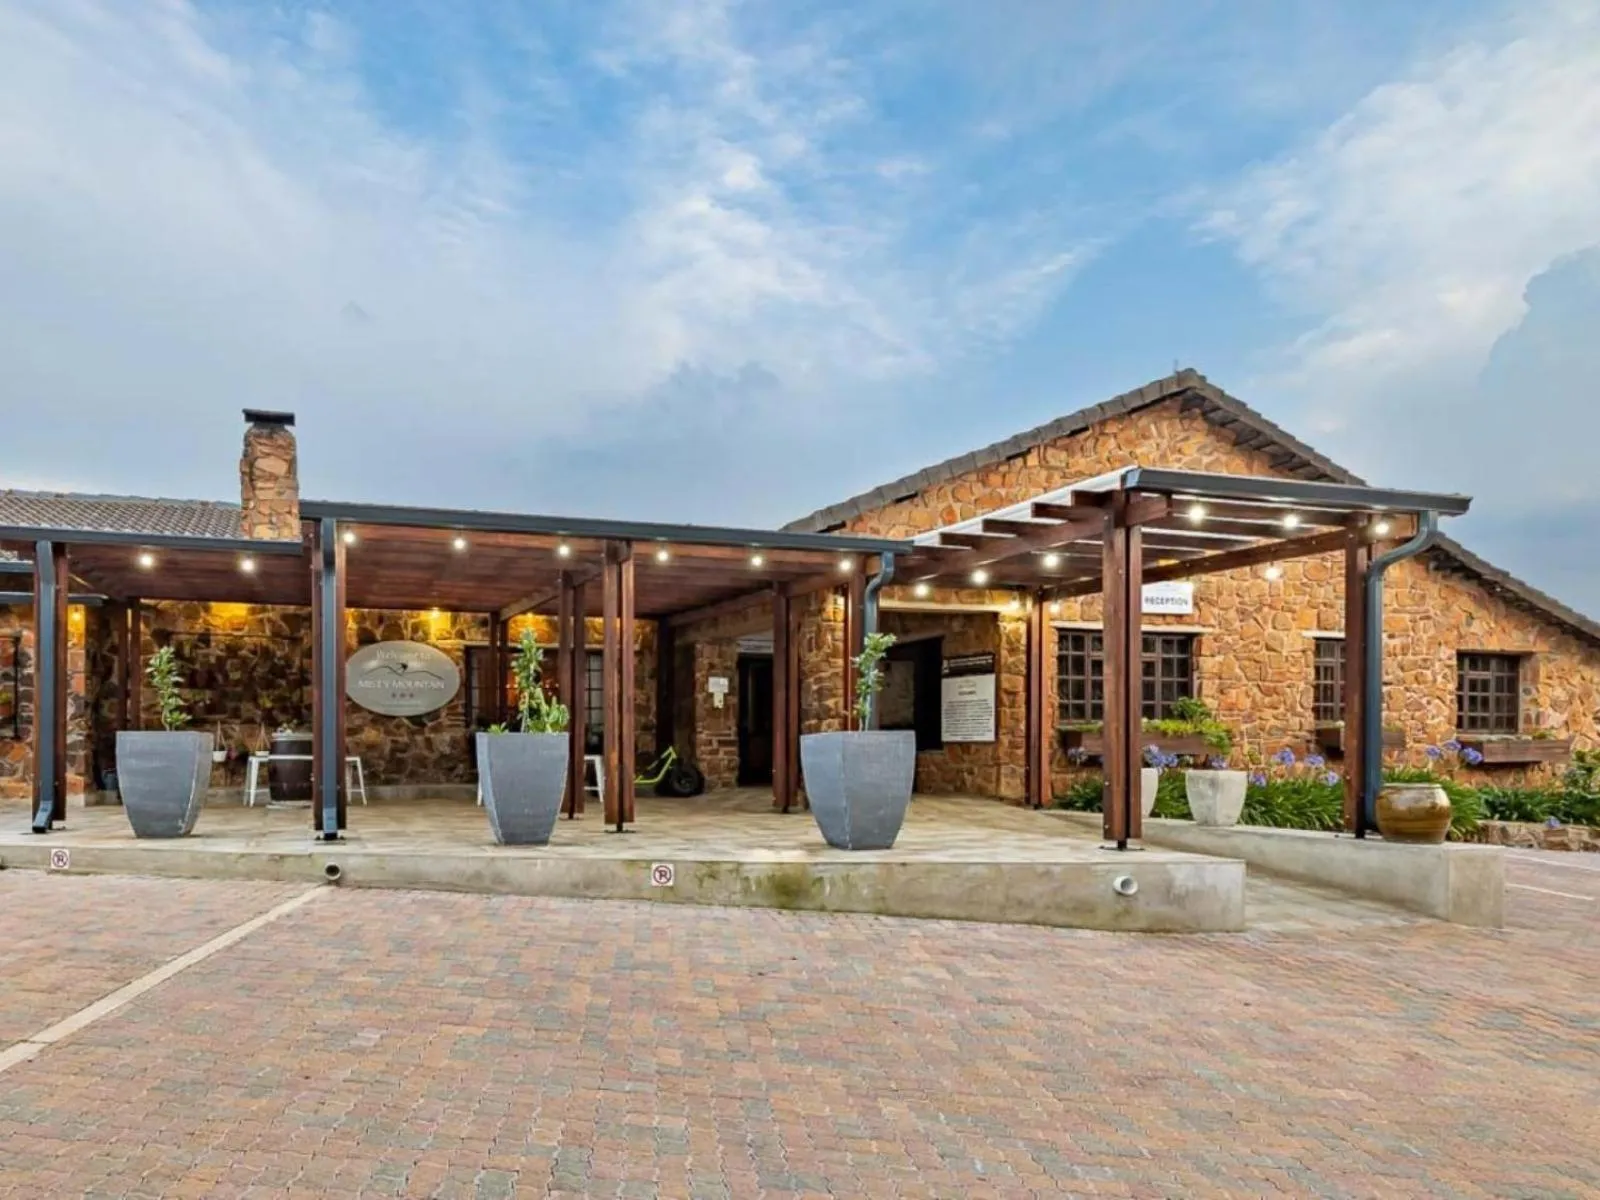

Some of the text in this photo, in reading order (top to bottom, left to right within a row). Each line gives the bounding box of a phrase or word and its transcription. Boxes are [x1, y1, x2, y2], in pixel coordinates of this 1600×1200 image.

[1144, 596, 1188, 606] RECEPTION
[357, 679, 445, 690] MISTY MOUNTAIN
